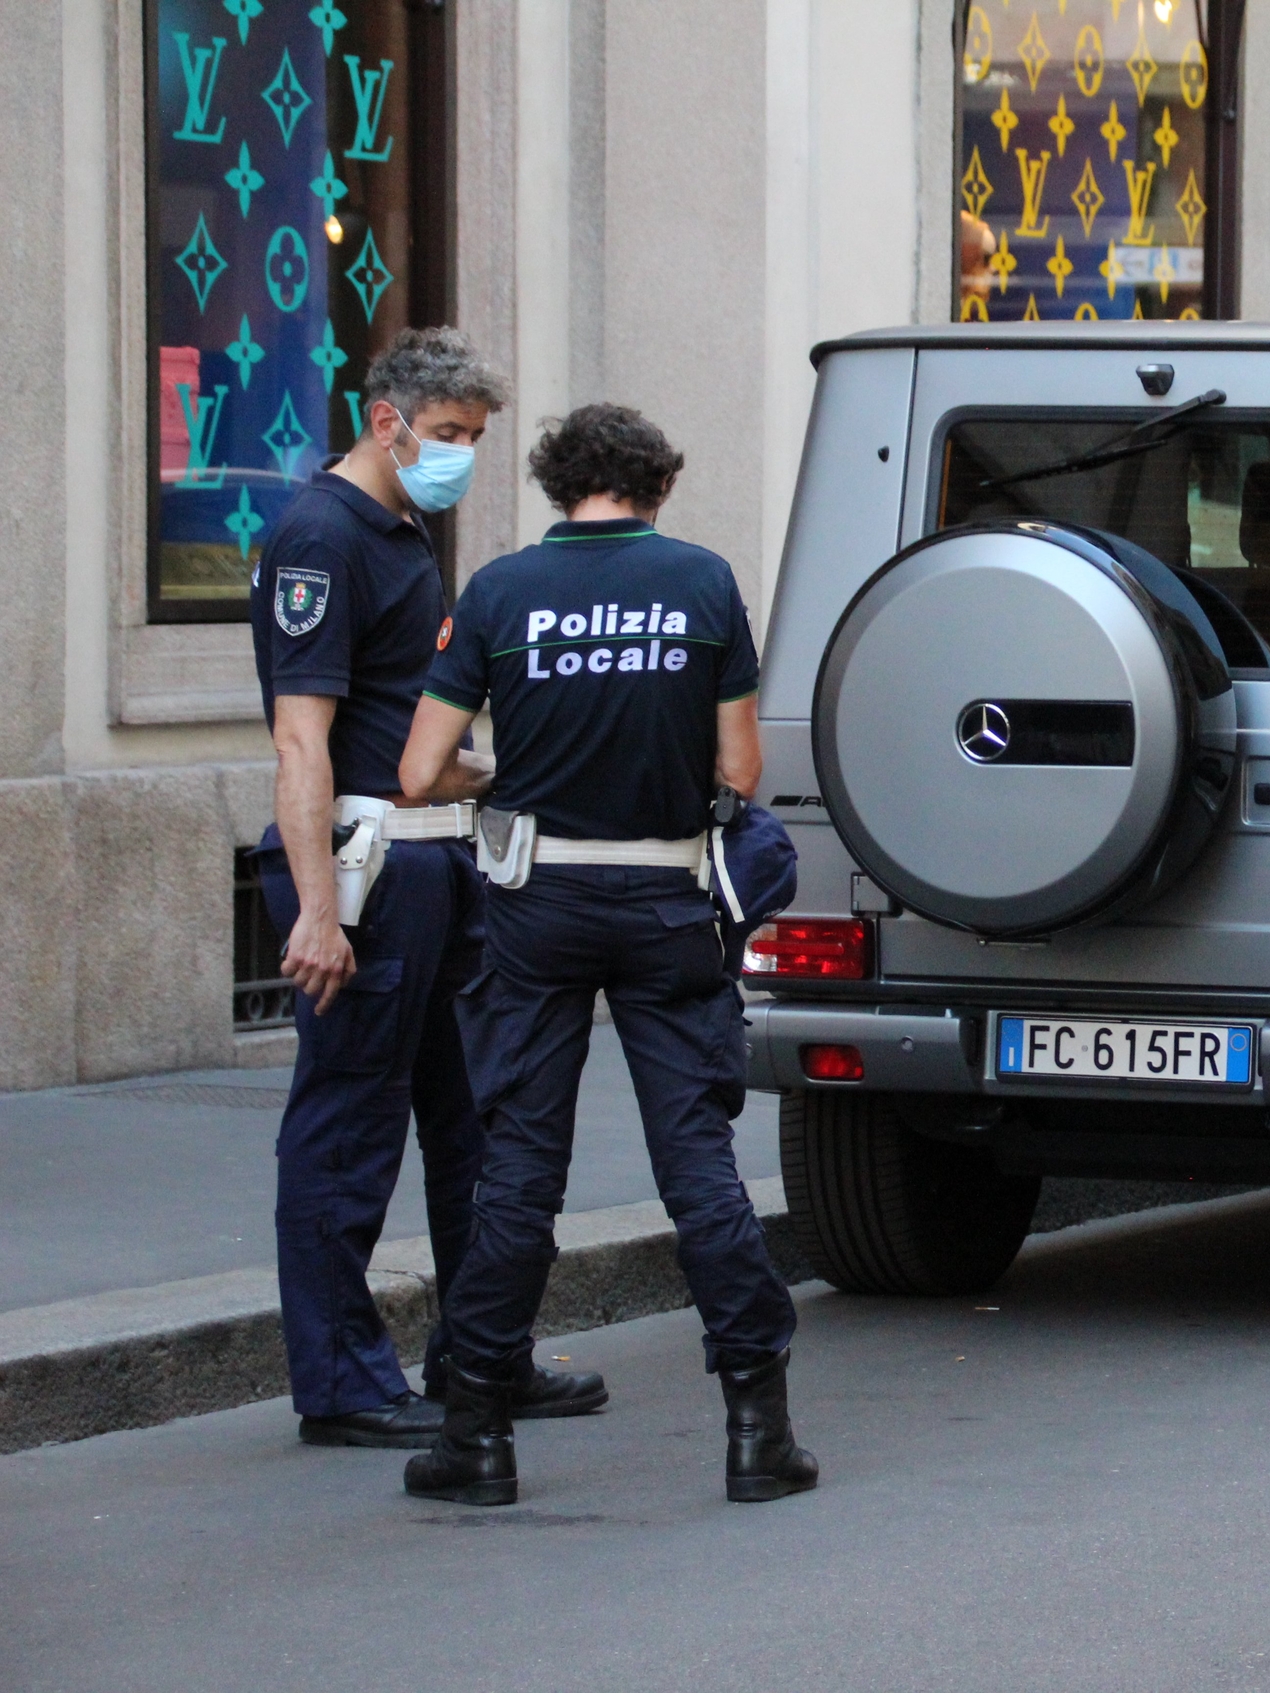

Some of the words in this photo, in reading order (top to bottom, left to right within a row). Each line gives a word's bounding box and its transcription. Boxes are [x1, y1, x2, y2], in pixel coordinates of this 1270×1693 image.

[302, 574, 327, 584] LOCALE
[290, 624, 299, 632] DI
[300, 596, 325, 630] MILANO
[527, 603, 688, 643] Polizia
[527, 639, 688, 679] Locale
